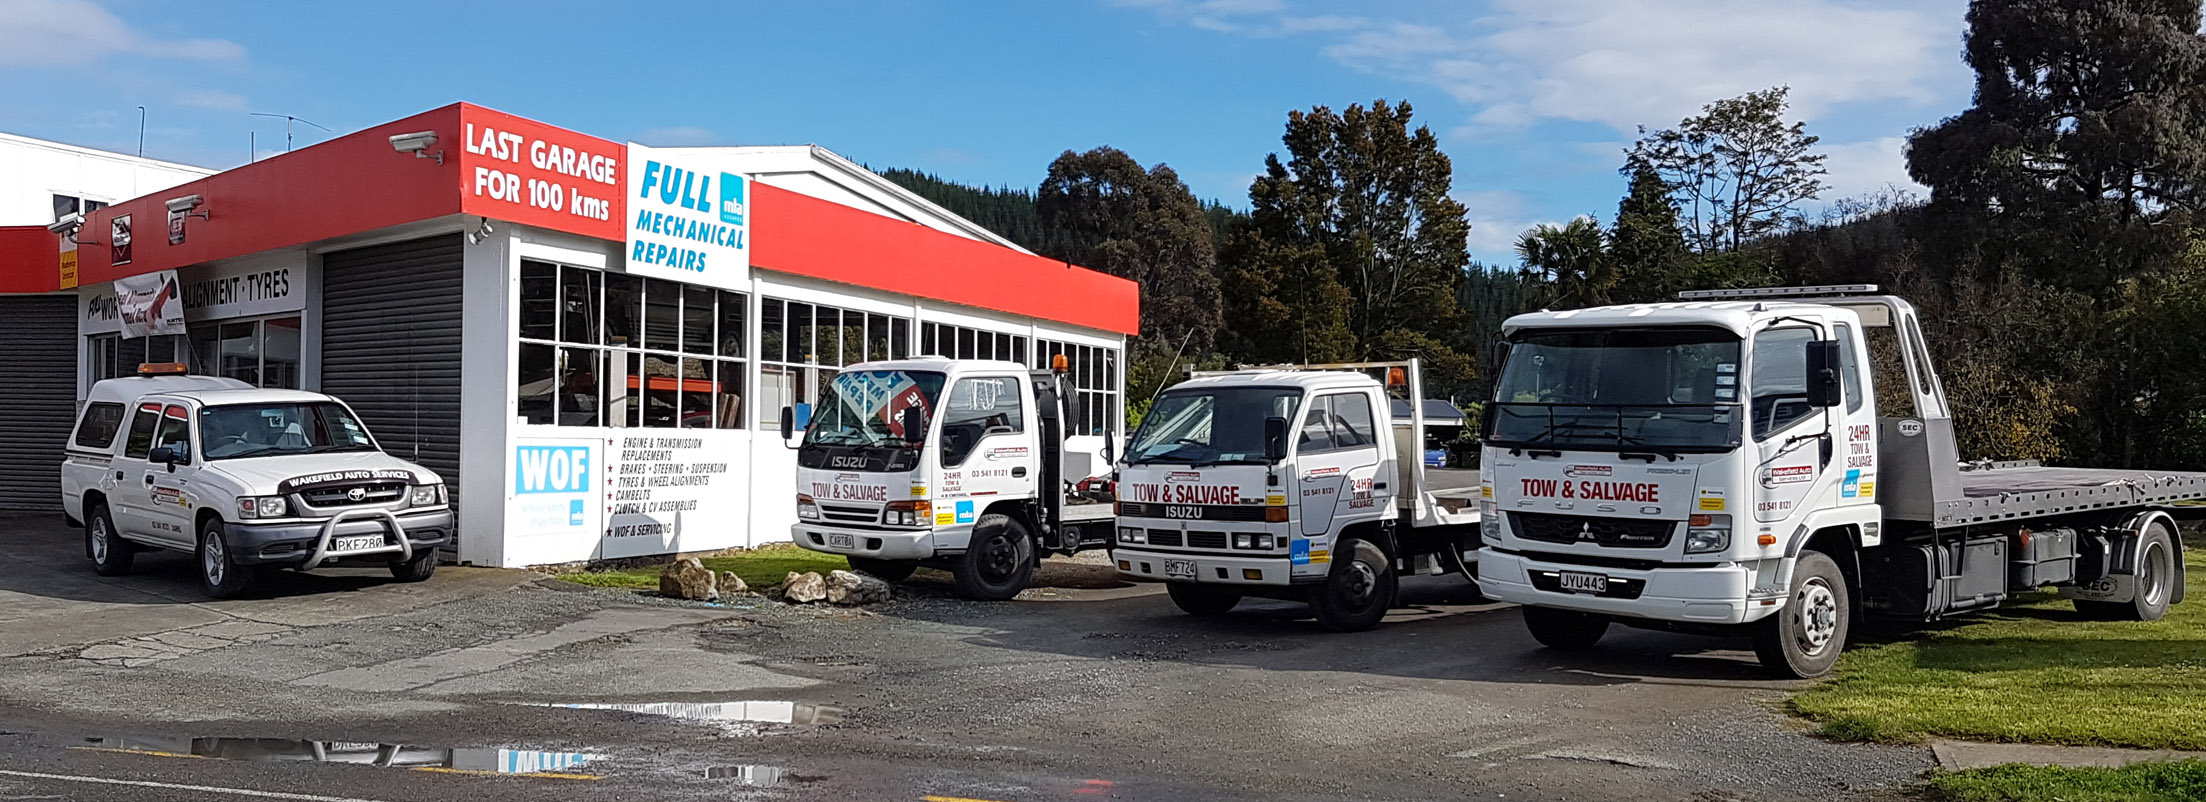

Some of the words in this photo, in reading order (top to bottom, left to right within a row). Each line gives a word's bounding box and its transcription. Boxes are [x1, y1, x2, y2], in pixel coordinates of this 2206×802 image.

[466, 122, 523, 163] LAST
[530, 139, 616, 185] GARAGE
[641, 160, 711, 213] FULL
[475, 166, 520, 204] FOR
[528, 178, 563, 212] 100
[570, 187, 609, 221] kms
[636, 209, 744, 250] MECHANICAL
[632, 240, 706, 273] REPAIRS
[247, 268, 289, 301] TYRES
[1848, 425, 1870, 442] 24HR
[623, 437, 648, 448] ENGINE
[649, 438, 654, 448] &
[656, 438, 702, 449] TRANSMISSION
[1850, 443, 1863, 455] TOW
[1865, 443, 1869, 454] &
[621, 450, 672, 461] REPLACEMENTS
[832, 456, 867, 468] ISUZU
[1847, 455, 1872, 468] SALVAGE
[520, 448, 587, 491] WOF
[620, 463, 646, 474] BRAKES
[653, 464, 684, 474] STEERING
[691, 463, 727, 473] SUSPENSION
[994, 469, 1008, 477] 8121
[289, 472, 344, 487] WAKEFIELD
[344, 471, 370, 480] AUTO
[371, 470, 410, 479] SERVICES
[618, 477, 639, 488] TYRES
[640, 476, 645, 487] &
[648, 476, 669, 487] WHEEL
[670, 476, 709, 486] ALIGNMENTS
[944, 472, 961, 480] 24HR
[1350, 478, 1373, 490] 24HR
[1521, 479, 1557, 497] TOW
[1561, 480, 1575, 498] &
[1580, 480, 1659, 502] SALVAGE
[615, 489, 651, 501] CAMBELTS
[812, 482, 830, 498] TOW
[833, 483, 841, 498] &
[843, 484, 887, 501] SALVAGE
[1132, 483, 1158, 502] TOW
[1162, 484, 1172, 503] &
[1176, 484, 1240, 505] SALVAGE
[1311, 488, 1320, 496] 541
[1322, 487, 1334, 495] 8121
[1352, 491, 1365, 500] TOW
[1366, 491, 1372, 499] &
[614, 502, 640, 514] CLUTCH
[642, 502, 647, 513] &
[648, 502, 657, 512] CV
[658, 500, 697, 511] ASSEMBLIES
[1349, 499, 1374, 509] SALVAGE
[1517, 499, 1661, 515] FUSO
[1758, 503, 1765, 511] 03
[1767, 502, 1777, 510] 541
[1779, 500, 1791, 510] 8121
[1165, 505, 1203, 518] ISUZU
[614, 525, 630, 537] WOF
[630, 524, 636, 536] &
[636, 523, 671, 536] SERVICING
[1165, 561, 1194, 573] BMF724
[1562, 574, 1606, 591] JYU443
